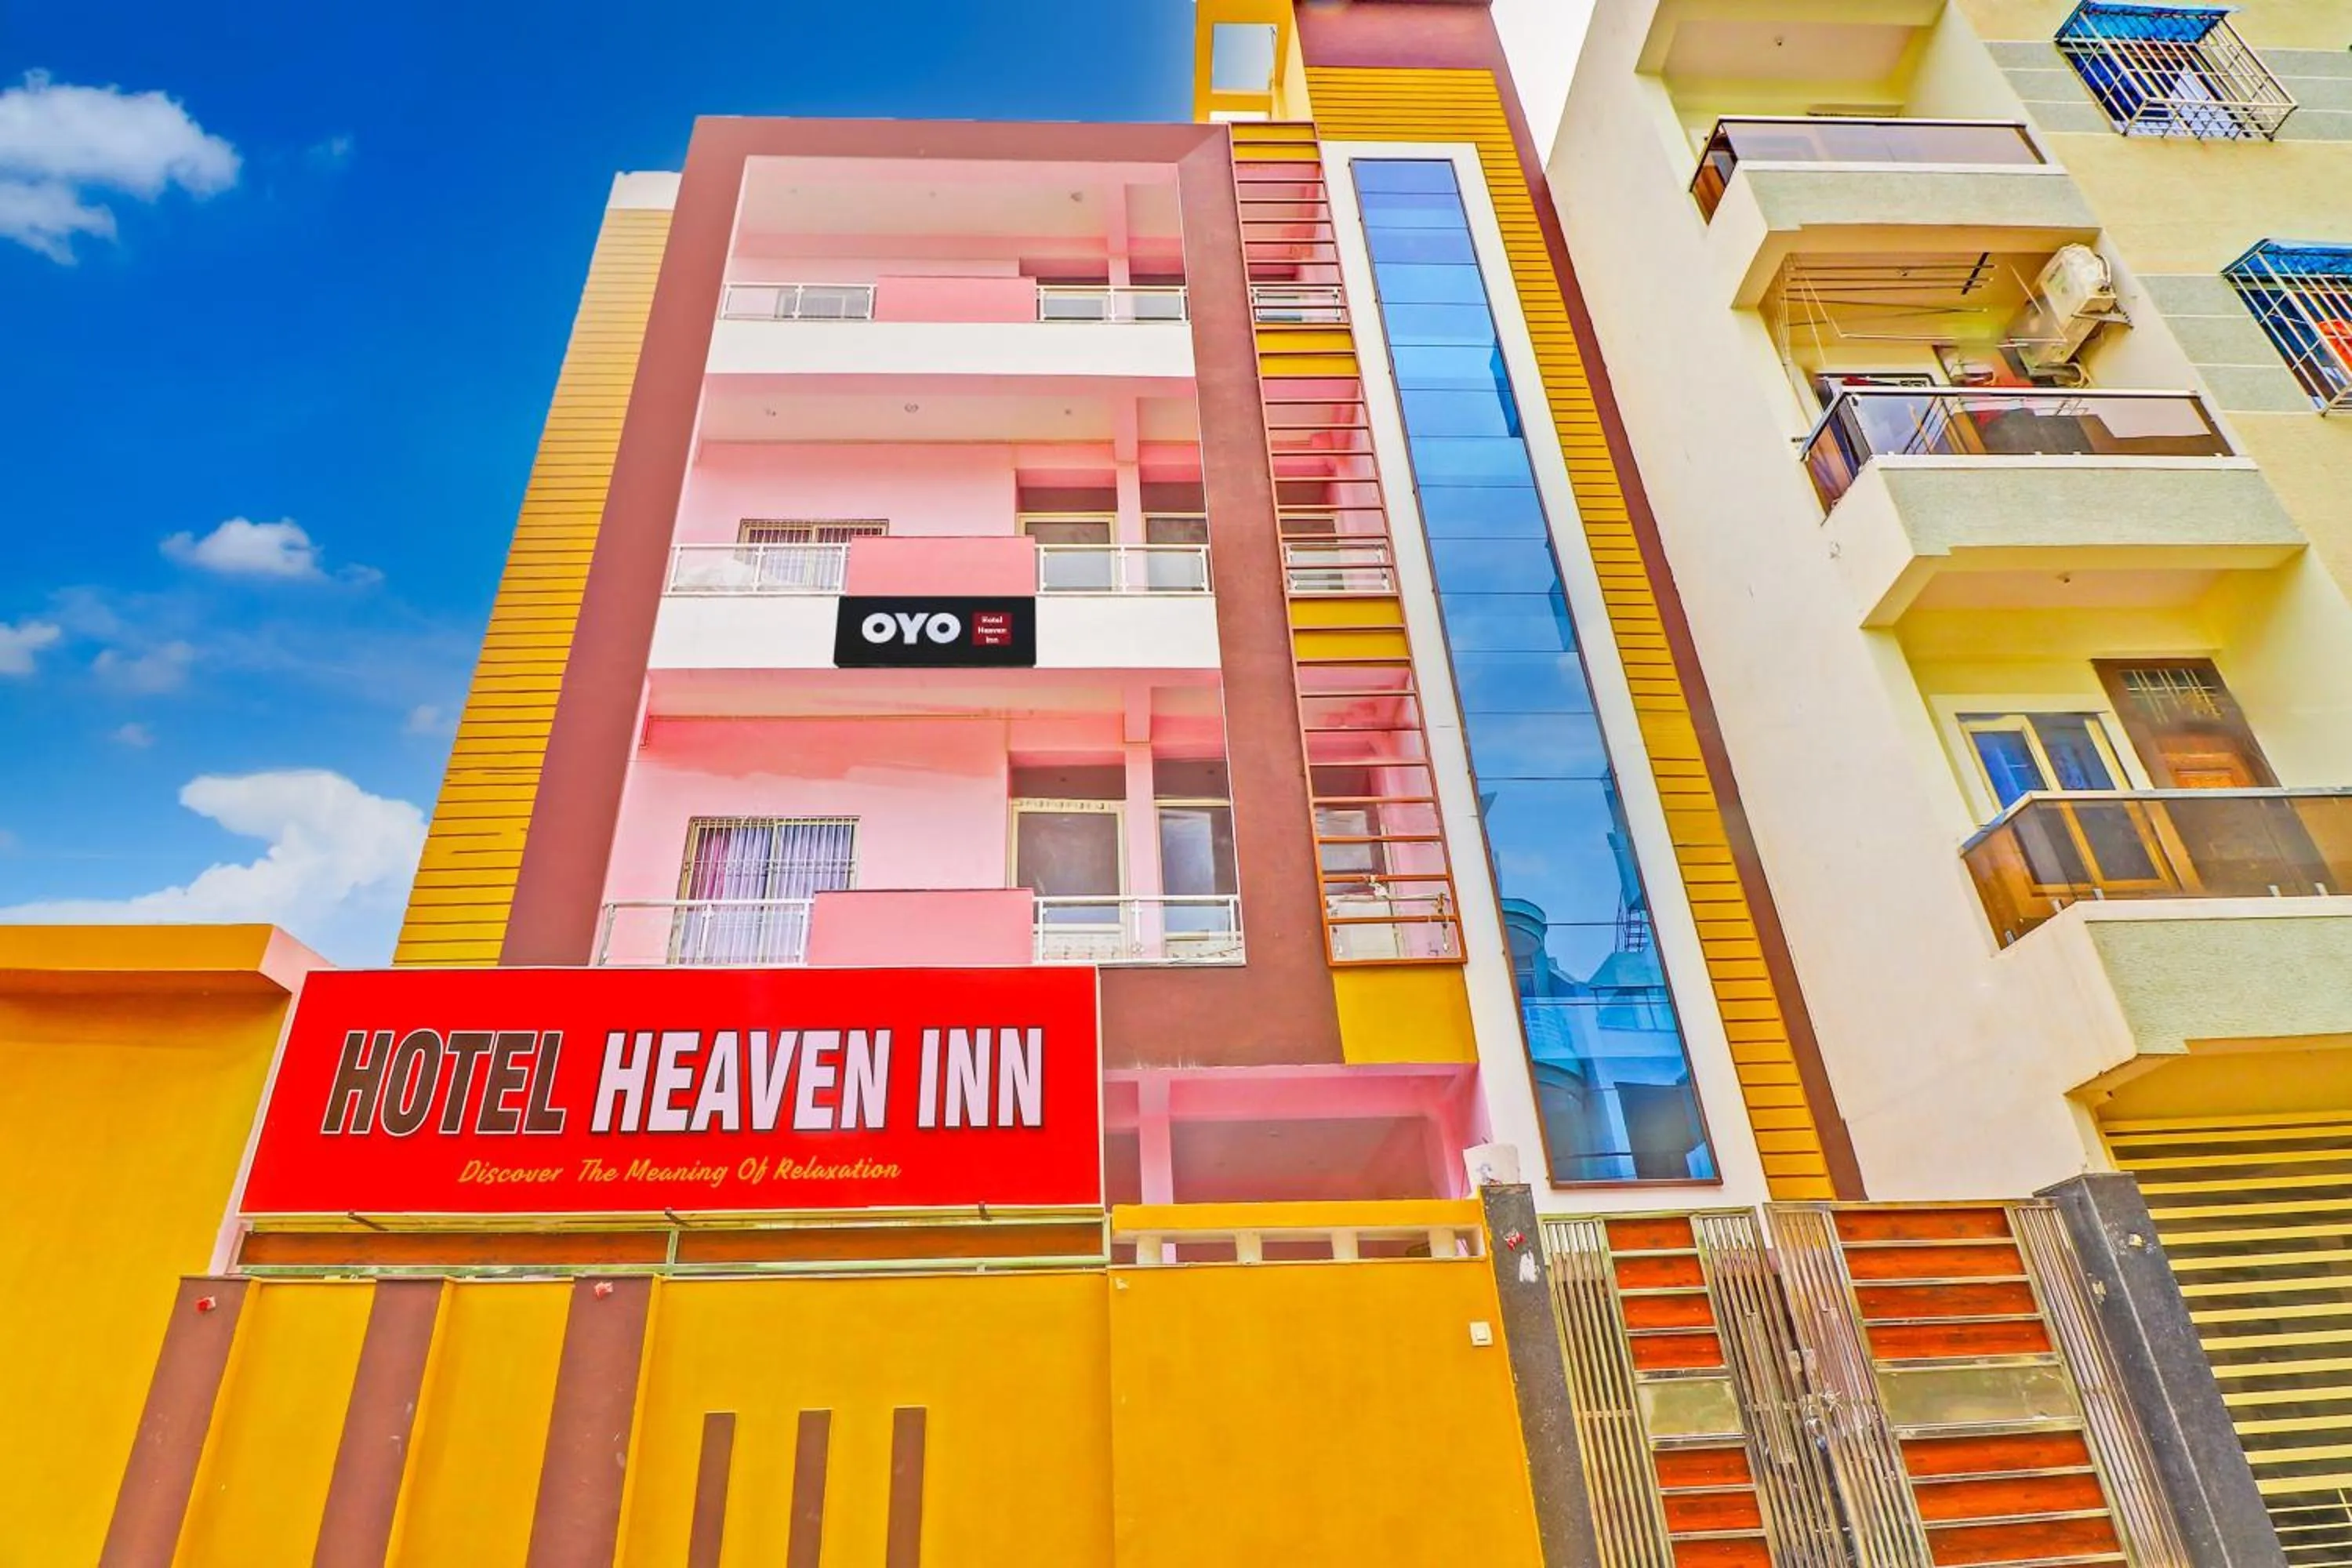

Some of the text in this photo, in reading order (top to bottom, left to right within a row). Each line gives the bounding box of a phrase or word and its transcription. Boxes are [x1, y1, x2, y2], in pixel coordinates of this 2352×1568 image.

[862, 612, 961, 644] OYO
[321, 1026, 1044, 1134] HOTEL HEAVEN INN
[457, 1156, 902, 1188] Discover The Meaning Of Relaxation
